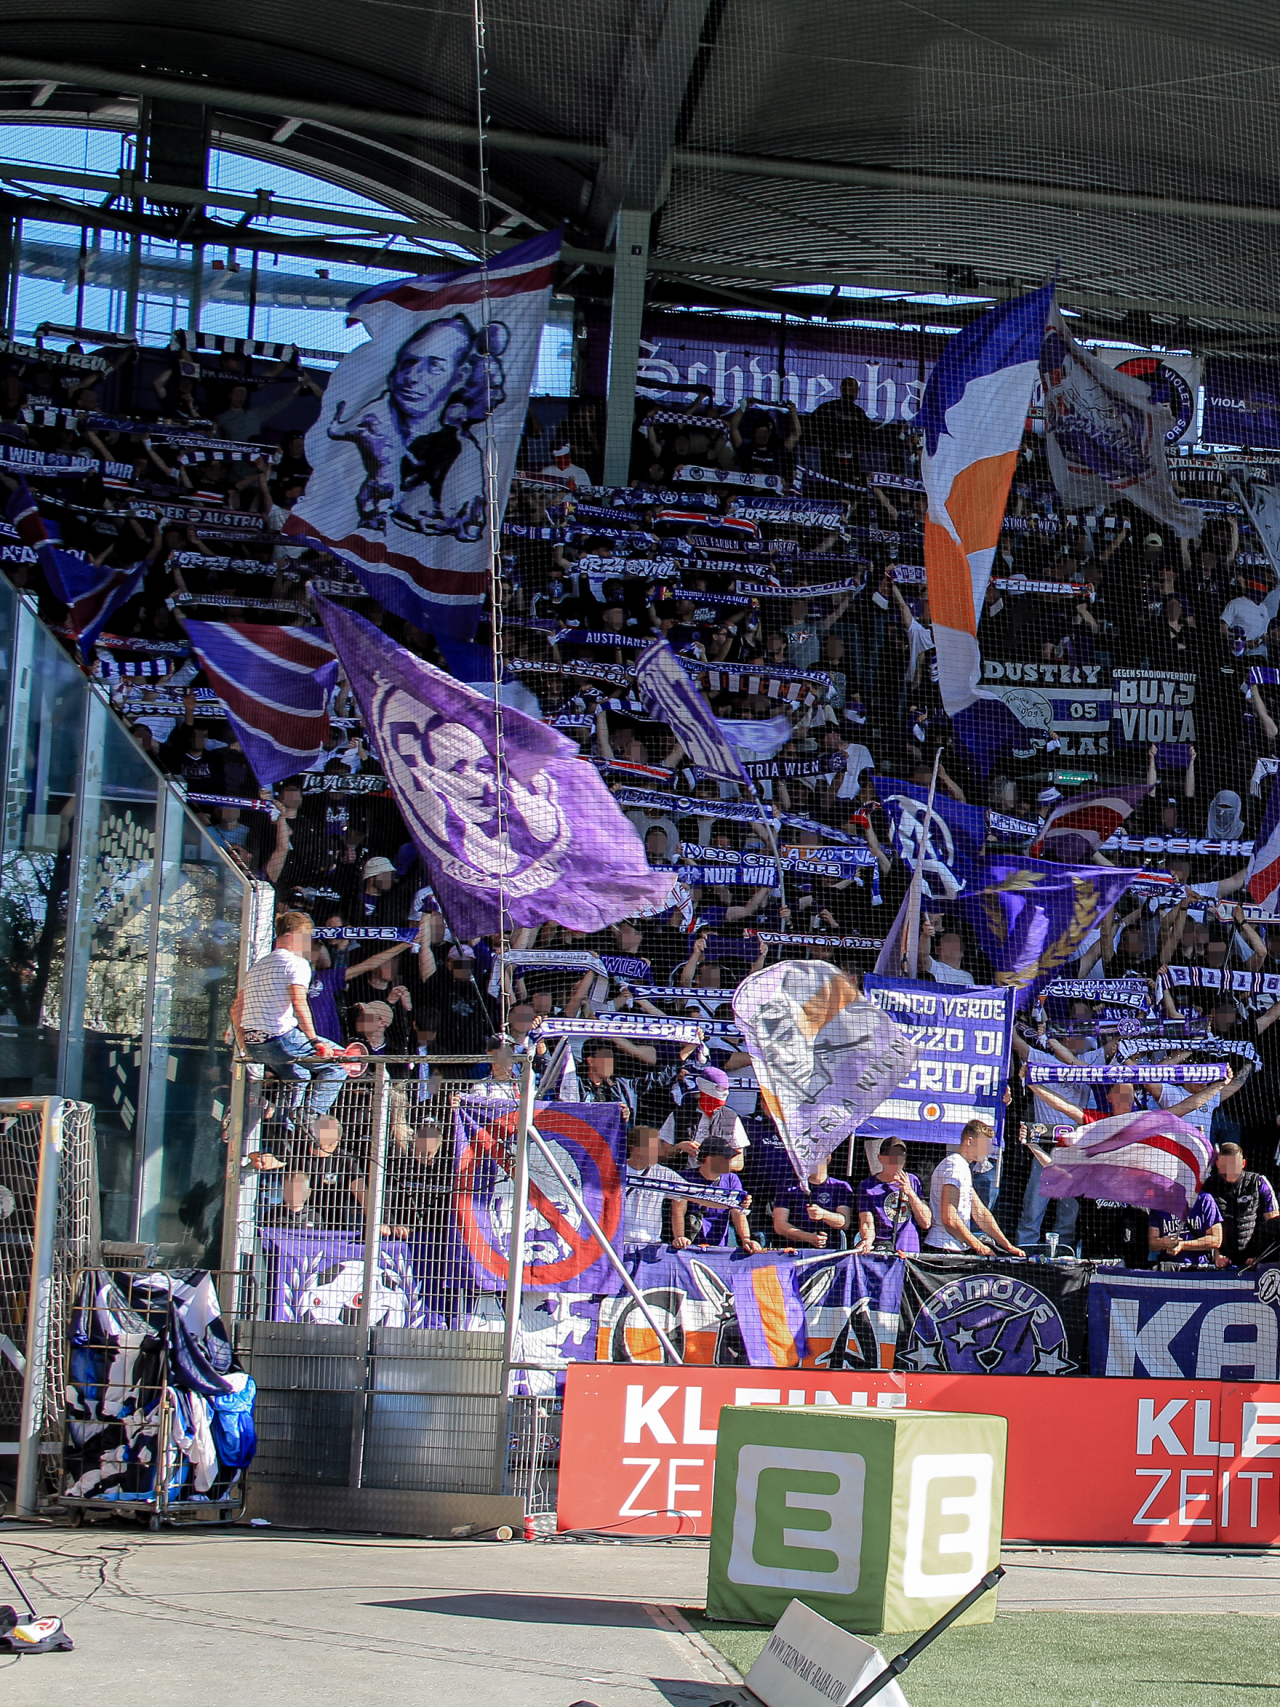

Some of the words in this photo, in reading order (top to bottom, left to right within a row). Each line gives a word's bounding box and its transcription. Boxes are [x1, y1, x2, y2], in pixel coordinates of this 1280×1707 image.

[1210, 397, 1246, 409] VIOLA
[809, 511, 843, 531] VIOL
[579, 557, 626, 574] ORZA
[642, 559, 680, 577] VIOL
[585, 631, 653, 649] AUSTRIANE
[984, 661, 1101, 684] DUSTRY
[1069, 702, 1098, 720] 05
[1119, 708, 1197, 743] VIOLA
[749, 763, 780, 778] TRIA
[784, 760, 820, 776] WIEN
[703, 848, 742, 864] BIG
[795, 860, 842, 877] LIFE
[703, 865, 737, 885] NUR
[742, 866, 777, 887] WIR
[312, 927, 341, 939] TY
[343, 926, 398, 939] LIFE
[601, 956, 649, 978] WIEN
[869, 988, 937, 1015] BIANCO
[941, 996, 1007, 1021] VERDE
[1100, 991, 1143, 1007] LIFE
[1105, 1007, 1138, 1020] AUST
[906, 1022, 966, 1052] ZZO
[974, 1029, 1004, 1056] DI
[898, 1059, 1000, 1097] ERDA!
[1031, 1065, 1054, 1084] IN
[1056, 1066, 1105, 1083] WIEN
[1137, 1066, 1177, 1083] NUR
[1181, 1066, 1221, 1083] WIR
[928, 1276, 1057, 1323] FAMOUS
